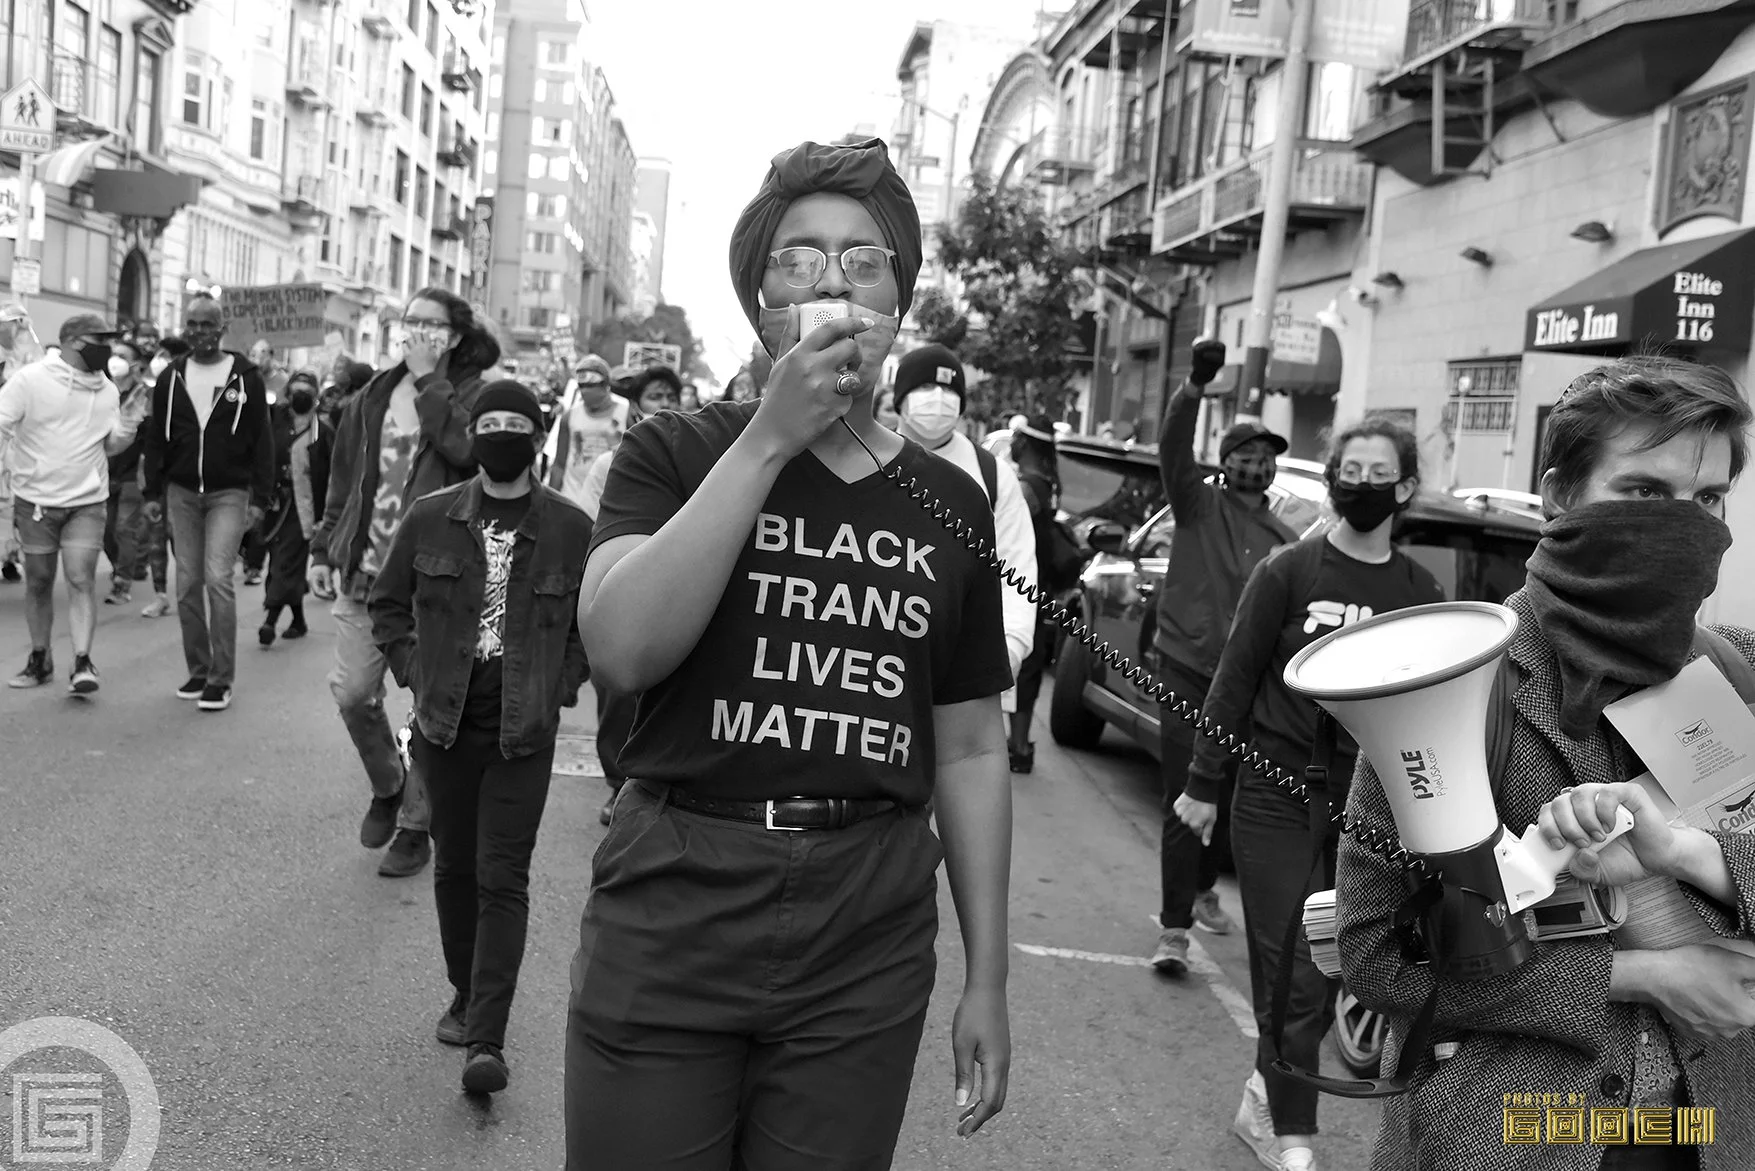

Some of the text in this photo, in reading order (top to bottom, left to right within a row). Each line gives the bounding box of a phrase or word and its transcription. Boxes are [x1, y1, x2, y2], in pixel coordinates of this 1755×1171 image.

[3, 131, 49, 149] AHEAD
[286, 287, 322, 303] SYSTEM
[1673, 271, 1723, 296] Elite
[1677, 295, 1715, 319] Inn
[1534, 304, 1618, 346] Elite Inn
[1676, 318, 1714, 342] 116
[755, 512, 936, 582] BLACK
[748, 571, 931, 639] TRANS
[753, 637, 906, 698] LIVES
[711, 698, 913, 767] MATTER
[1682, 726, 1710, 744] Condor
